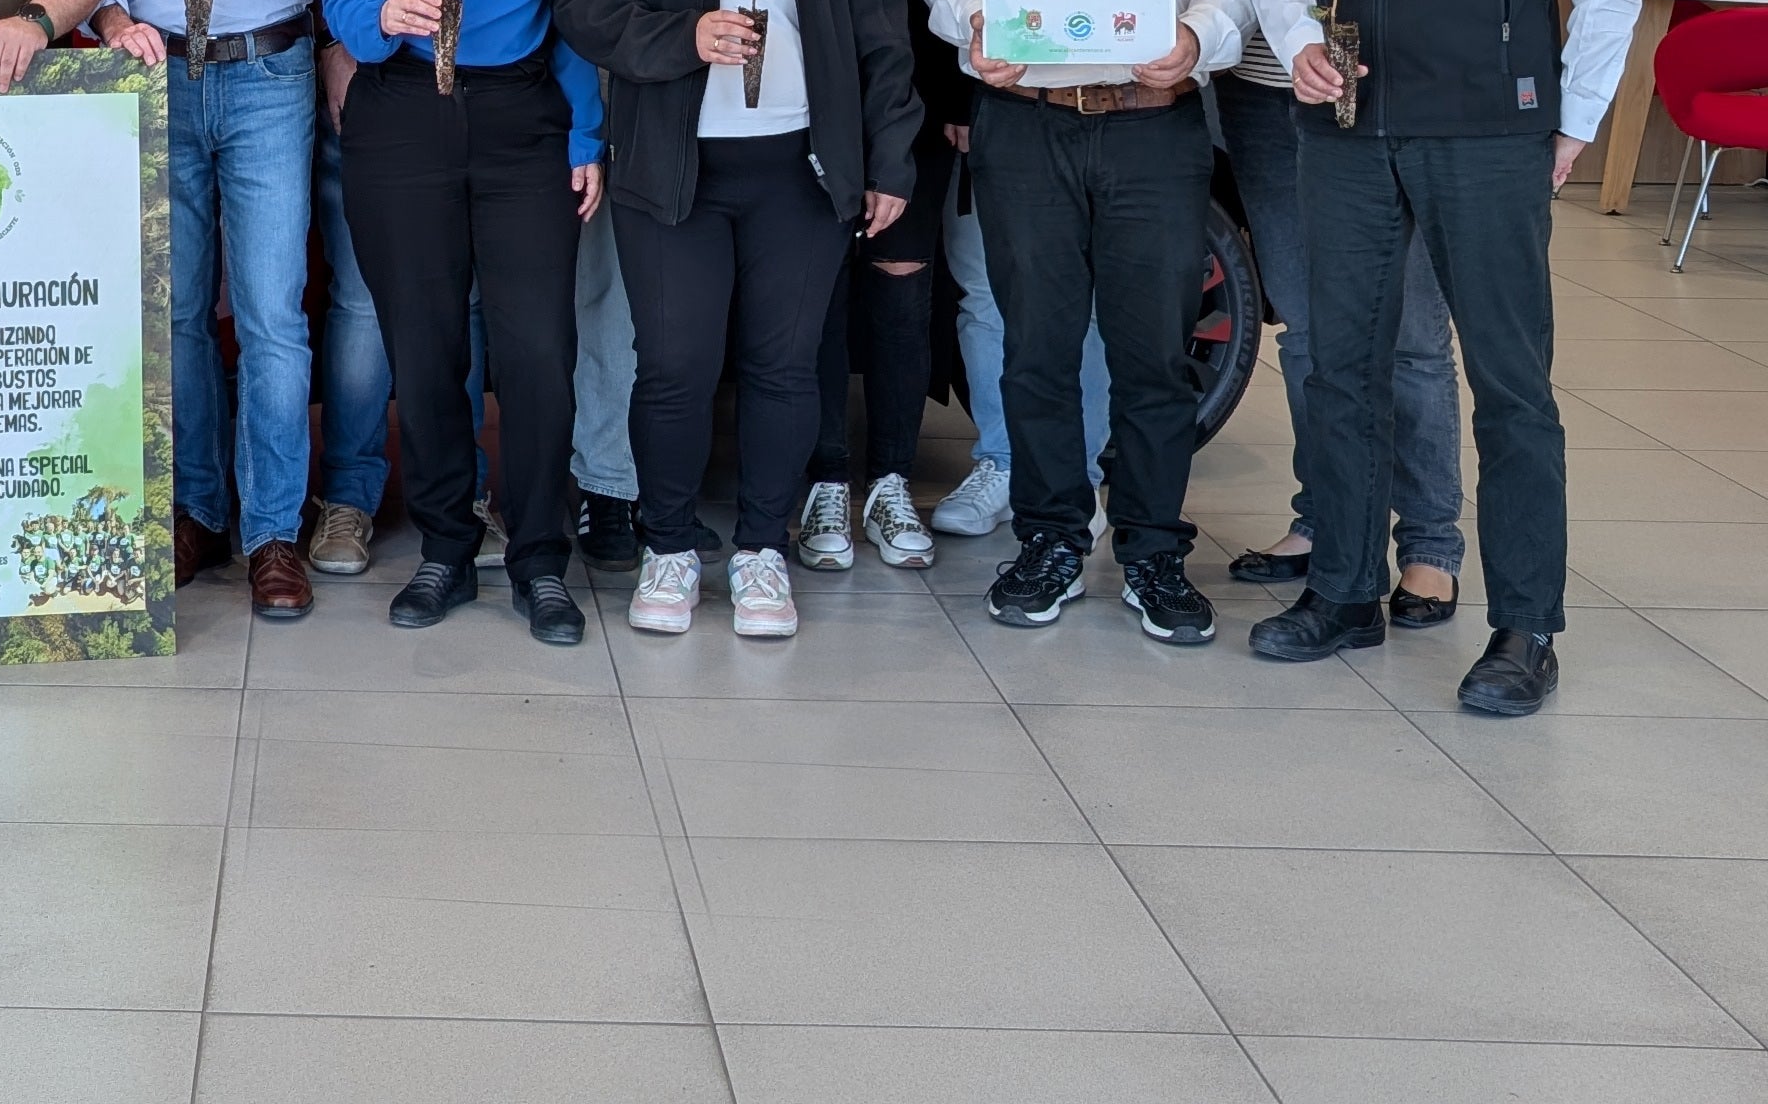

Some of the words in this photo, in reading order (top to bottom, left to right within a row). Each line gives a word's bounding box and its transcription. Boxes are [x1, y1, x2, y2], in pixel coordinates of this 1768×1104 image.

[74, 346, 94, 365] DE
[8, 389, 82, 411] MEJORAR
[19, 454, 94, 476] ESPECIAL
